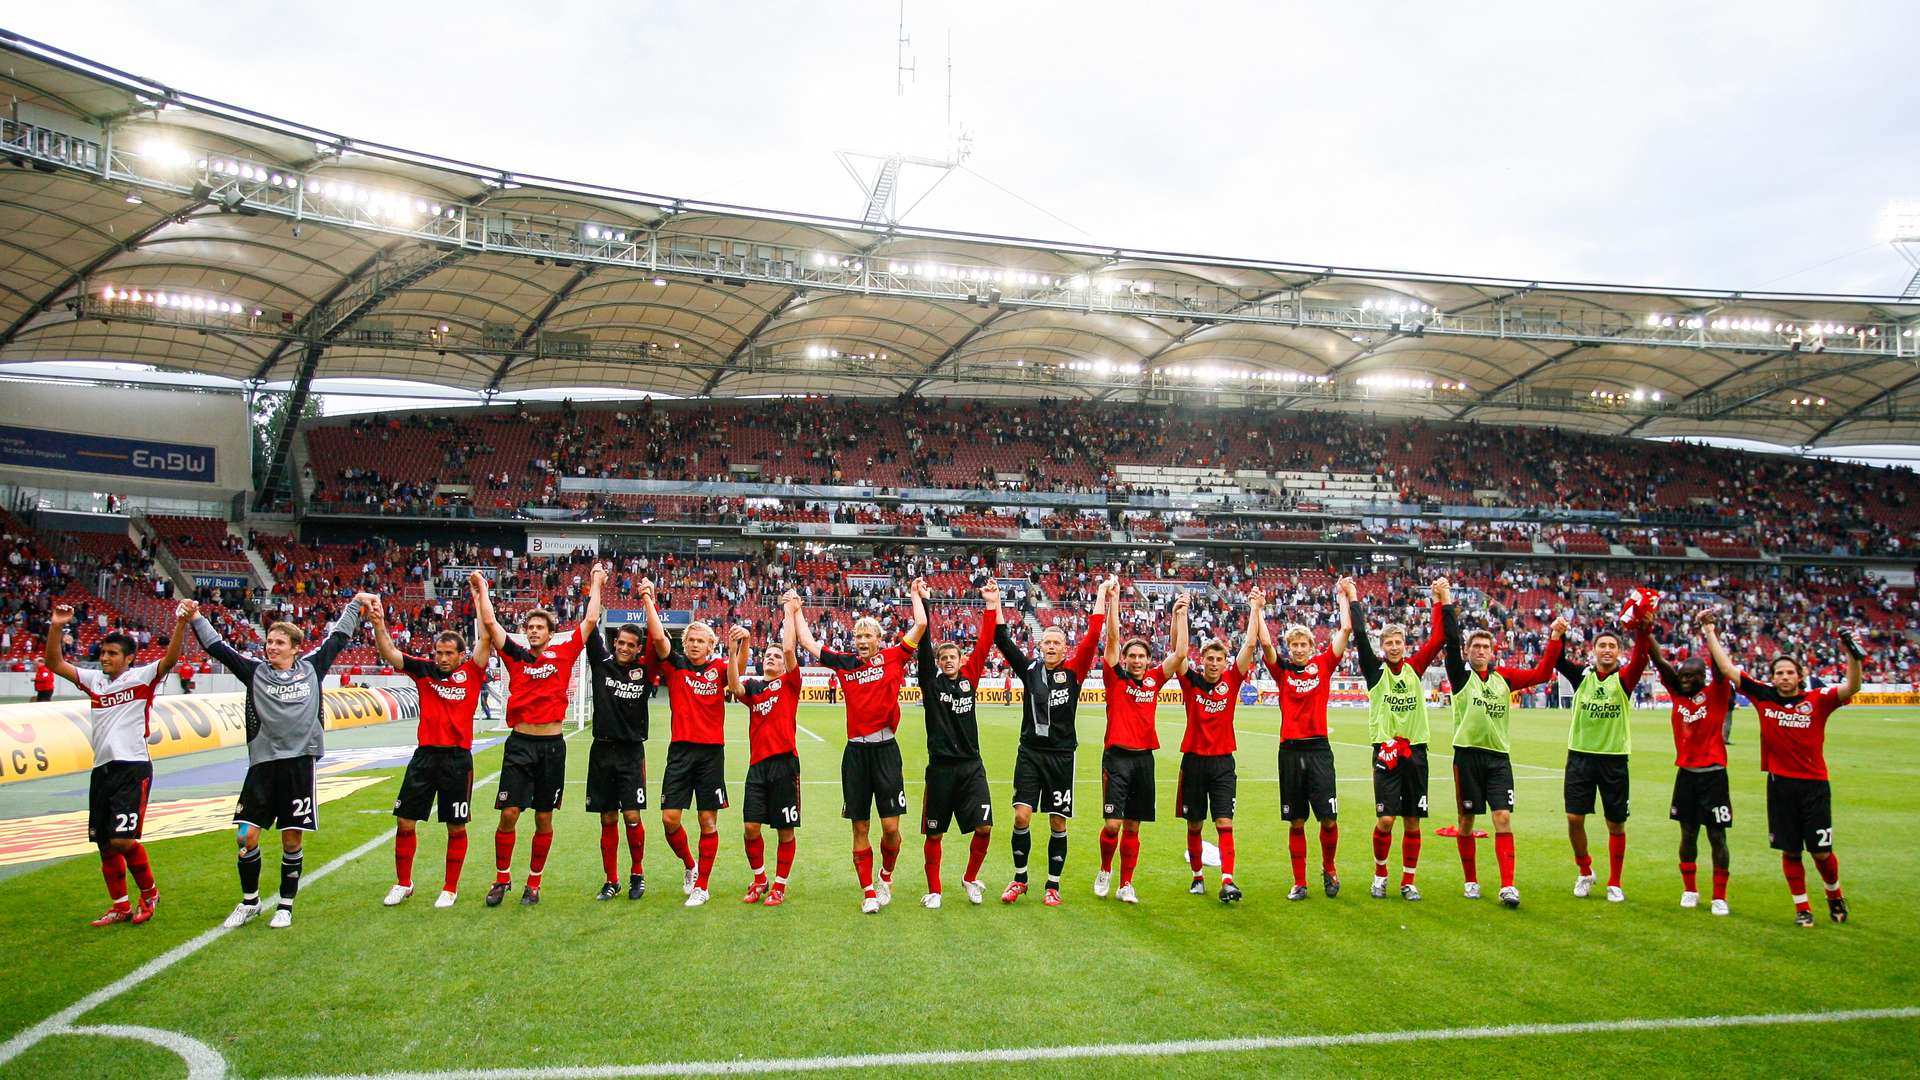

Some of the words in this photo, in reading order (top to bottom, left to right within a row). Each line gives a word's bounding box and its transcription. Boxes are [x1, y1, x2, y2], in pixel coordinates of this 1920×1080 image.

[132, 449, 206, 473] EnBW
[195, 577, 212, 586] BW
[215, 578, 241, 588] Bank
[627, 613, 642, 621] BW
[266, 681, 310, 696] TelDaFax
[604, 676, 644, 691] TelDaFax
[100, 689, 134, 707] EnBW
[280, 689, 312, 701] ENERGY
[614, 688, 643, 699] ENERGY
[1049, 695, 1070, 707] ERGY
[1158, 692, 1183, 703] SWR1
[1590, 711, 1621, 719] ENERGY
[1764, 708, 1811, 722] TelDaFax
[1778, 719, 1811, 729] ENERGY
[636, 787, 645, 804] 8
[898, 790, 906, 808] 6
[1053, 789, 1072, 807] 34
[1417, 795, 1428, 811] 4
[1507, 789, 1514, 806] 3
[292, 797, 312, 817] 22
[451, 801, 469, 818] 10
[781, 805, 799, 823] 16
[981, 804, 991, 821] 7
[1711, 805, 1731, 824] 18
[115, 813, 138, 833] 23
